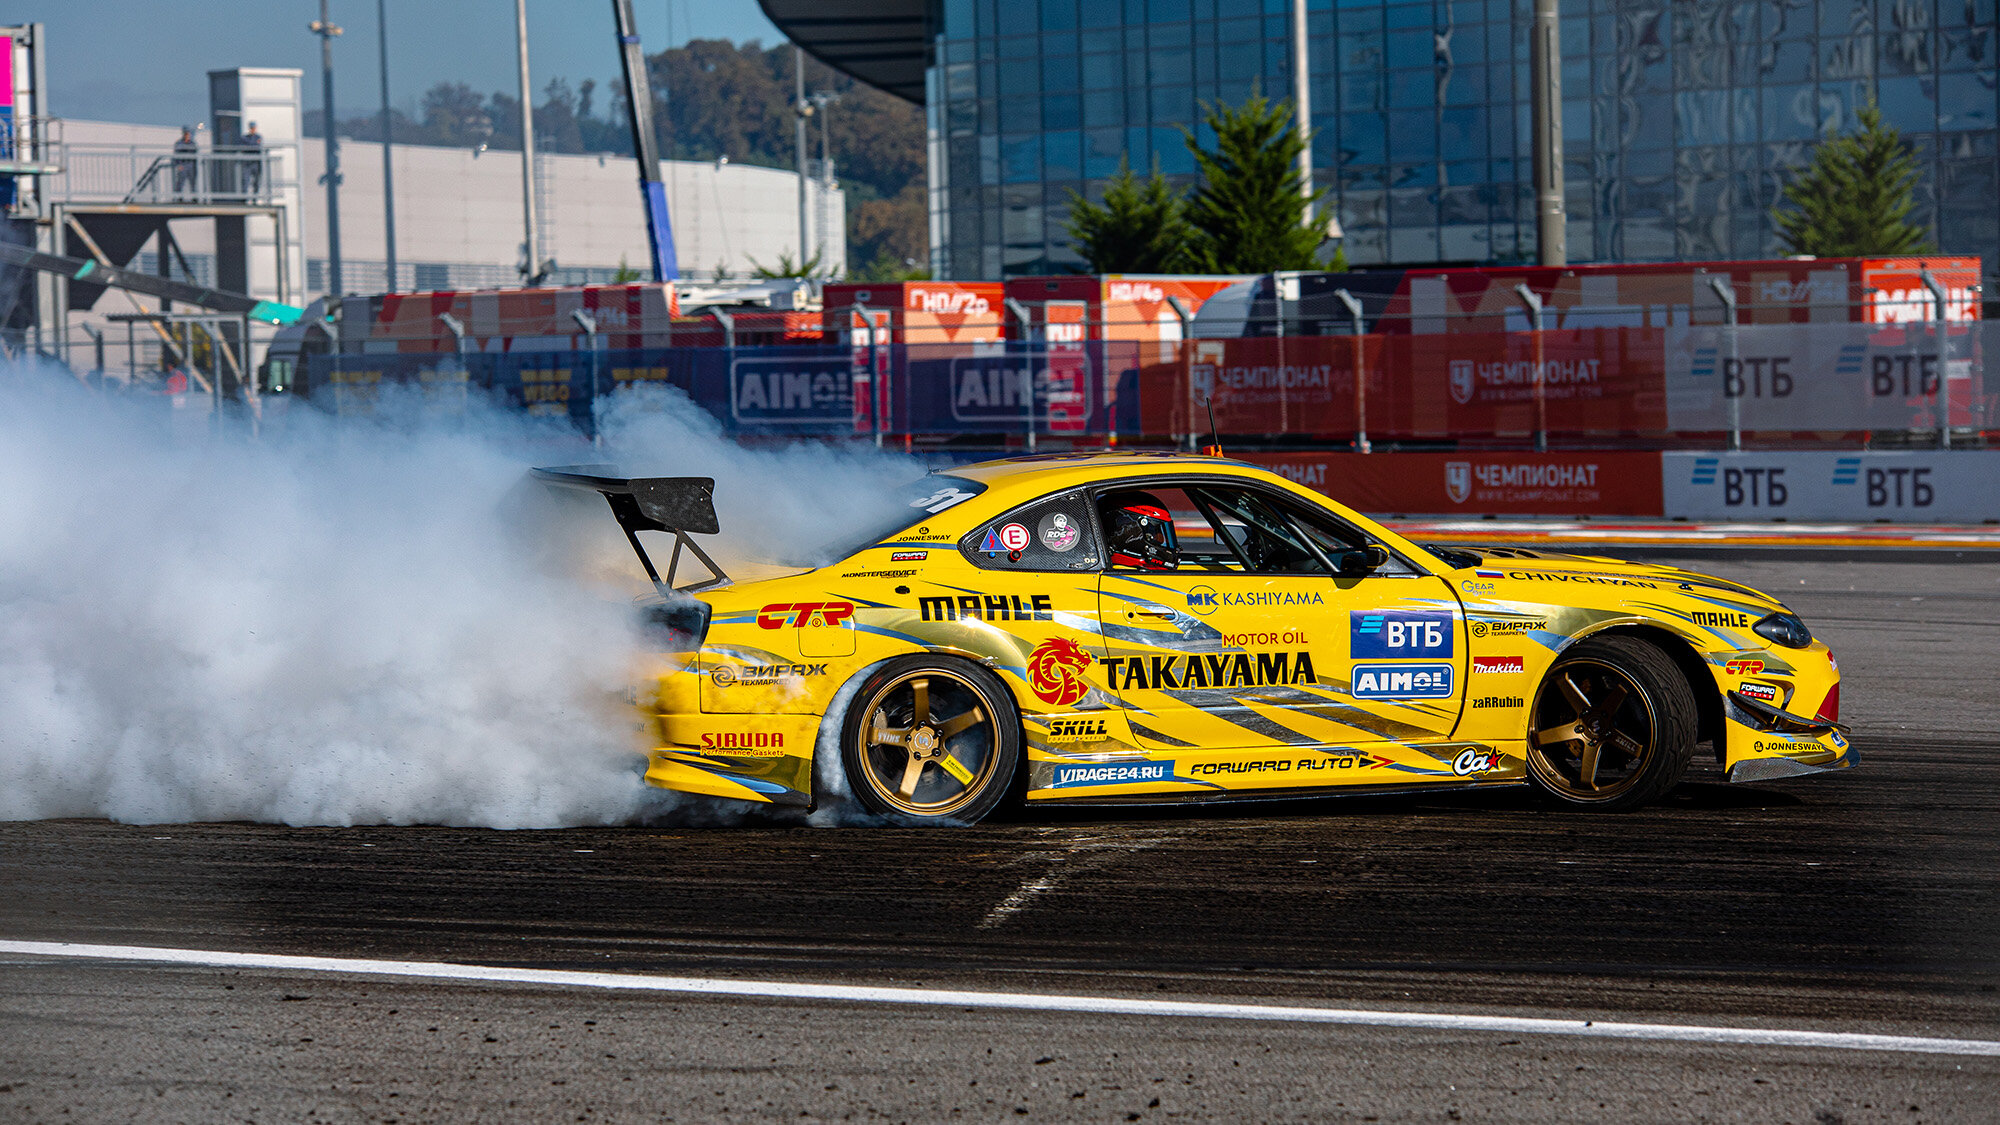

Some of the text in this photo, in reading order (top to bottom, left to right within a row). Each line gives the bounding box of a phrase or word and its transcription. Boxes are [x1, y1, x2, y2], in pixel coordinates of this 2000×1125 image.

[1477, 360, 1600, 385] ЧЕМПИОНАТ
[1723, 356, 1794, 398] ВТБ
[1872, 354, 1941, 397] ВТБ
[1475, 465, 1598, 486] ЧЕМПИОНАТ
[1724, 468, 1788, 507] ВТБ
[1867, 468, 1934, 507] ВТБ
[1008, 530, 1022, 545] E
[841, 569, 917, 577] MONSTERSERVICE
[1509, 571, 1659, 590] CHIVCHYAN
[1186, 592, 1324, 606] MK KASHIYAMA
[757, 601, 854, 630] CTR
[919, 594, 1053, 623] MAHLE
[1491, 621, 1547, 631] ВИРАЖ
[1691, 611, 1748, 628] MAHLE
[1223, 632, 1309, 646] MOTOR OIL
[1386, 619, 1443, 648] ВТБ
[741, 663, 829, 678] ВИРАЖ
[1100, 651, 1318, 691] TAKAYAMA
[1473, 662, 1524, 674] makita
[1725, 661, 1764, 675] CTR
[1356, 671, 1448, 692] AIMOL
[1741, 684, 1775, 695] FORWARD
[1472, 696, 1524, 709] zaRRubin
[1050, 720, 1107, 736] SKILL
[701, 732, 784, 748] SIRUDA
[1765, 742, 1822, 751] JONNESWAY
[701, 749, 751, 757] Performance
[1060, 766, 1164, 783] VIRAGE24.RU
[1191, 757, 1354, 775] FORWARD AUTO
